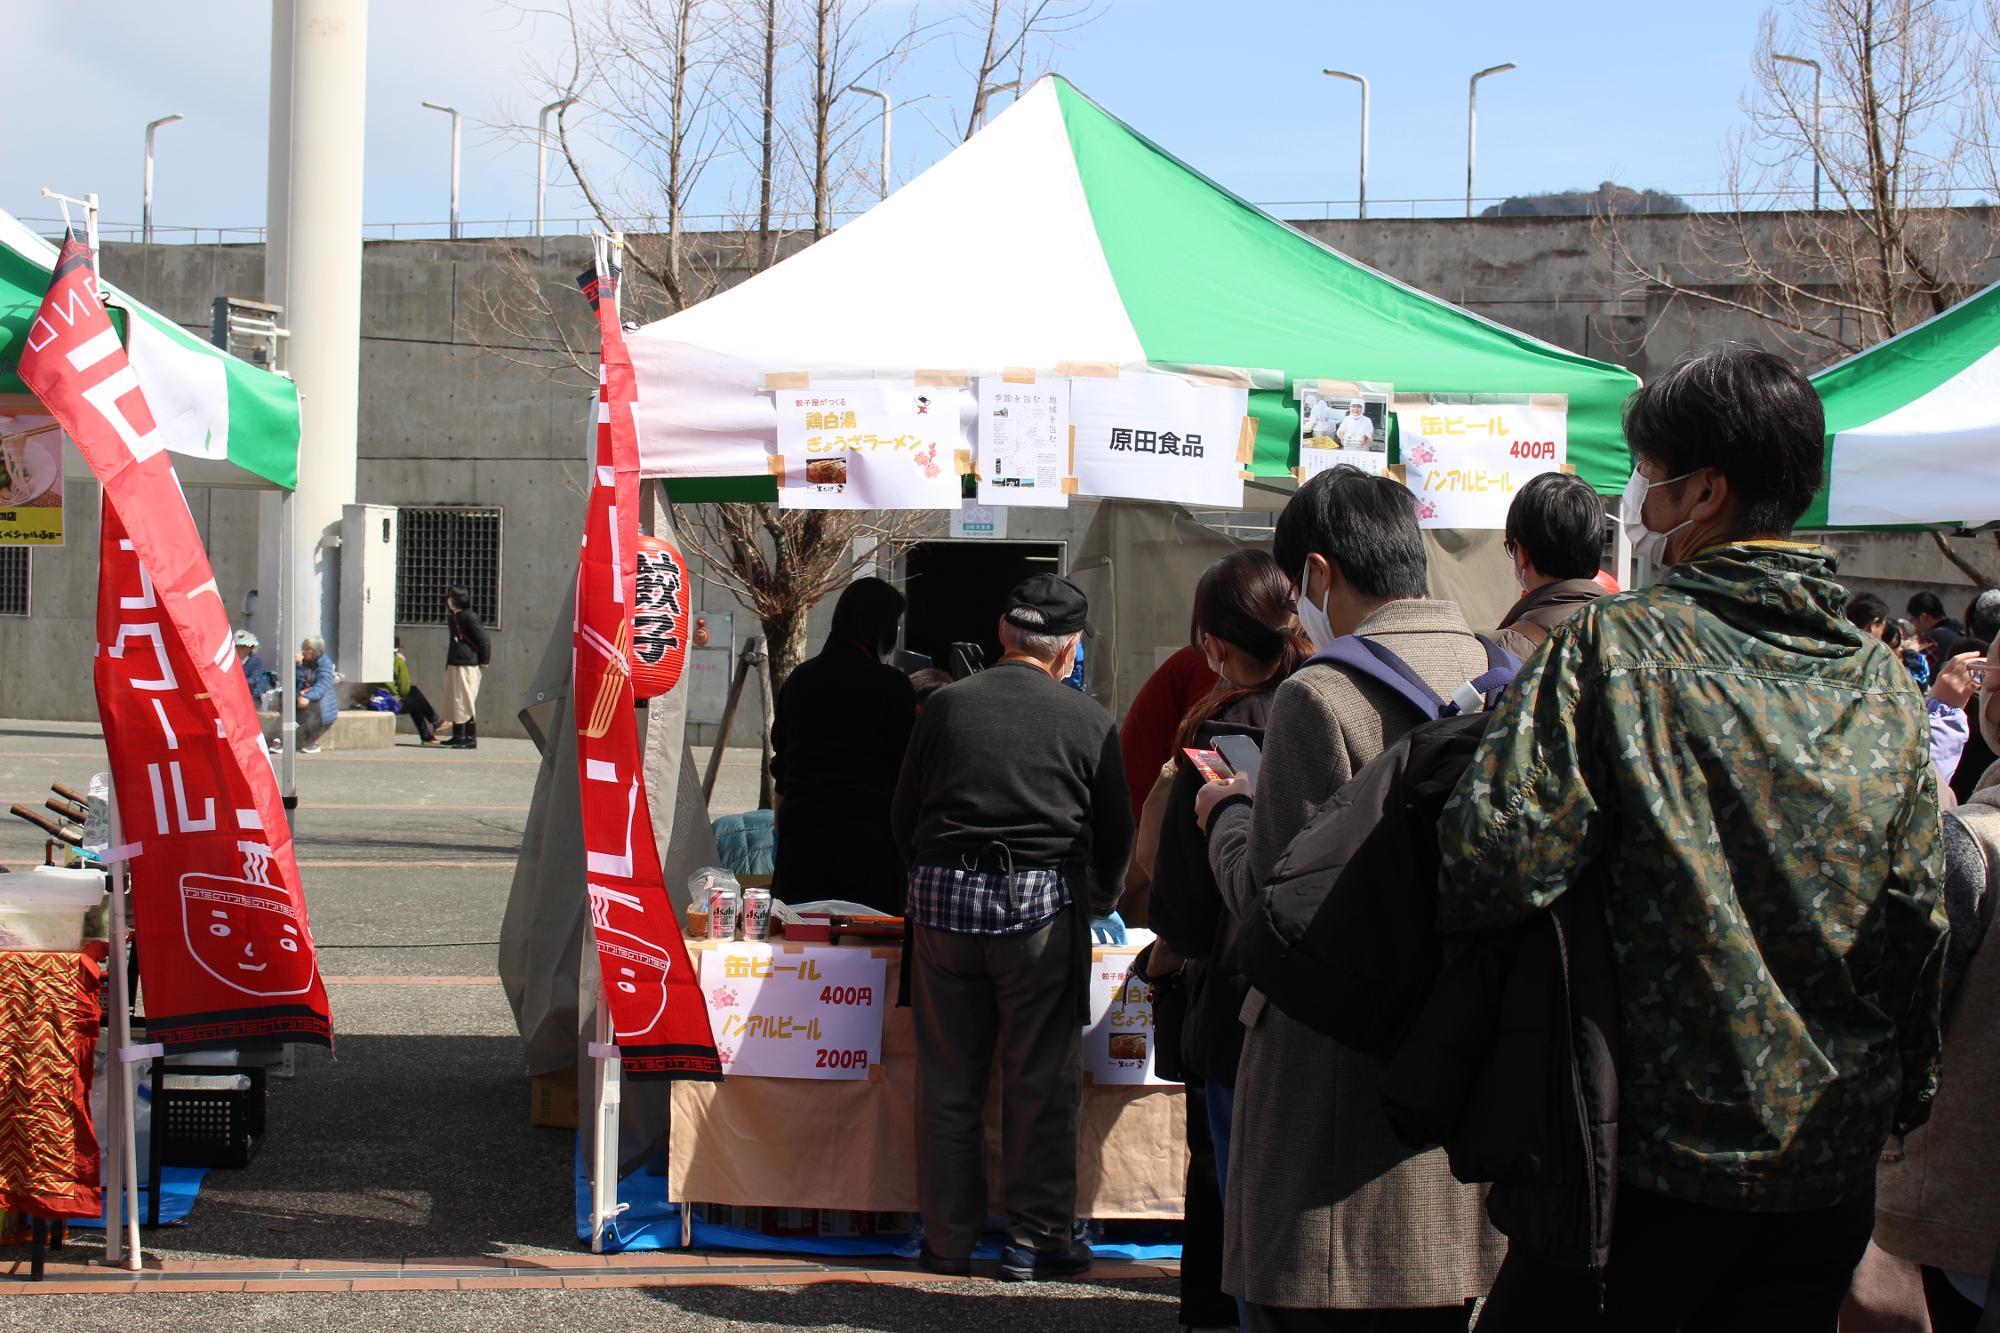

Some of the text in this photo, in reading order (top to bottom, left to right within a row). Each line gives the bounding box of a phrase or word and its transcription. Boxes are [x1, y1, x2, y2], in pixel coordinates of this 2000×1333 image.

[795, 398, 847, 407] 餃子屋がつくる
[805, 411, 857, 430] 鶏白湯
[1419, 415, 1510, 437] 缶ビール
[807, 434, 922, 453] ぎょうざラーメン
[1109, 427, 1204, 458] 原田食品
[1510, 441, 1556, 460] 400円
[1423, 469, 1514, 492] ノンアルビール
[634, 550, 681, 664] 餃子
[713, 906, 734, 916] Asahi
[725, 954, 822, 980] 缶ビール
[820, 985, 872, 1007] 400円
[722, 1014, 822, 1041] ノンアルビール
[1111, 1009, 1153, 1028] ぎょう
[816, 1049, 868, 1070] 200円
